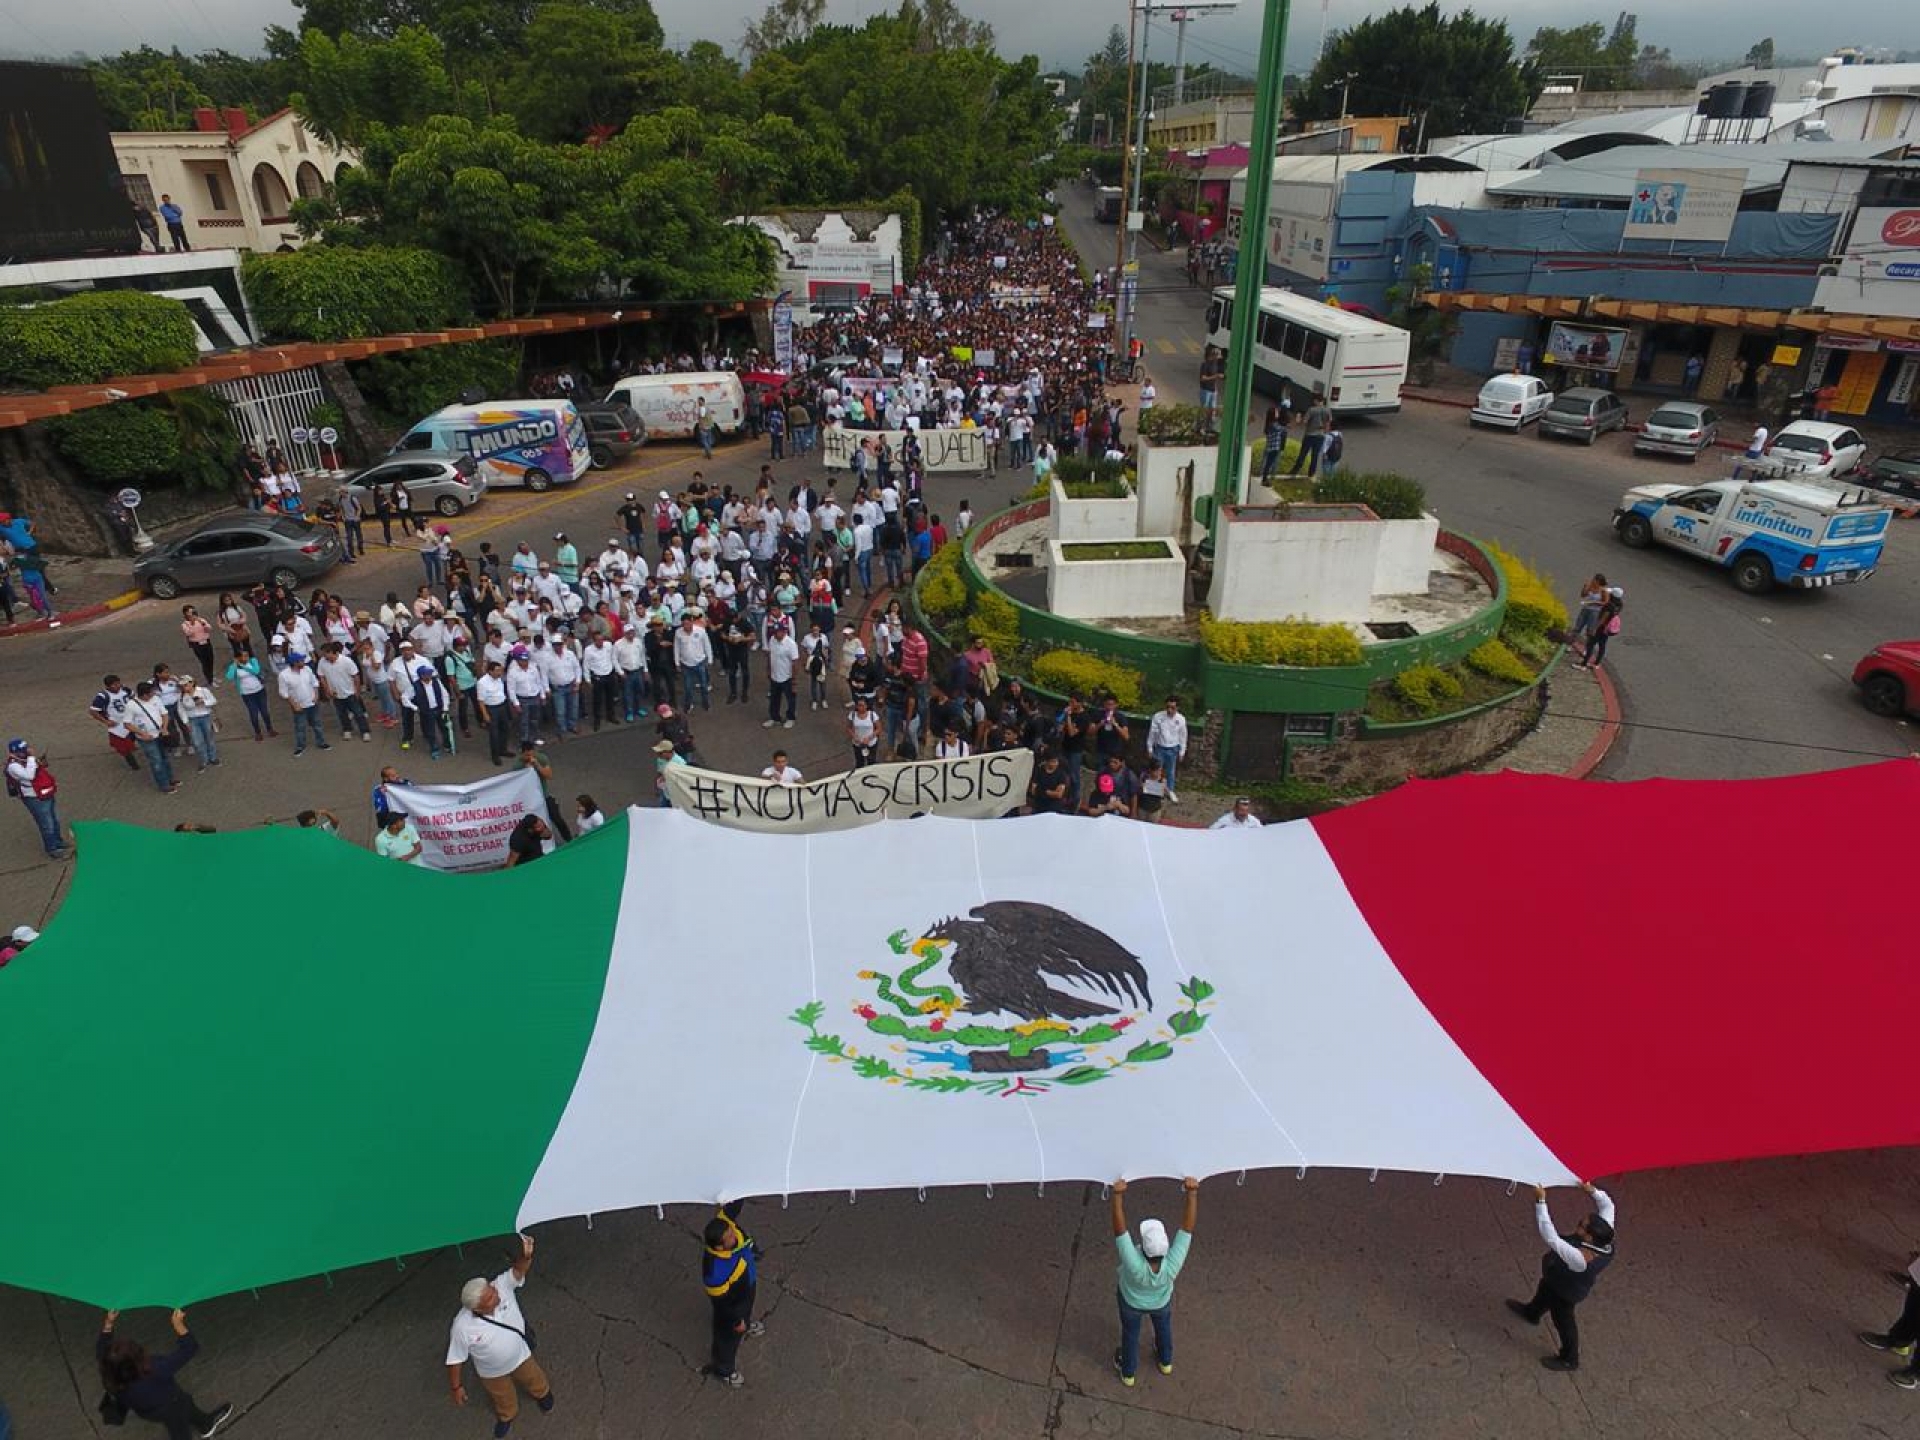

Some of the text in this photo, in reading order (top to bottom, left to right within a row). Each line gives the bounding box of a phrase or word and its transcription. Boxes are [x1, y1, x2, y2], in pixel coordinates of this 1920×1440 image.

[470, 419, 557, 459] MUNDO
[1735, 507, 1813, 540] infinitum
[432, 813, 454, 826] NOS
[456, 805, 510, 823] CANSAMOS
[513, 802, 525, 814] DE
[459, 827, 479, 840] NOS
[443, 844, 457, 856] DE
